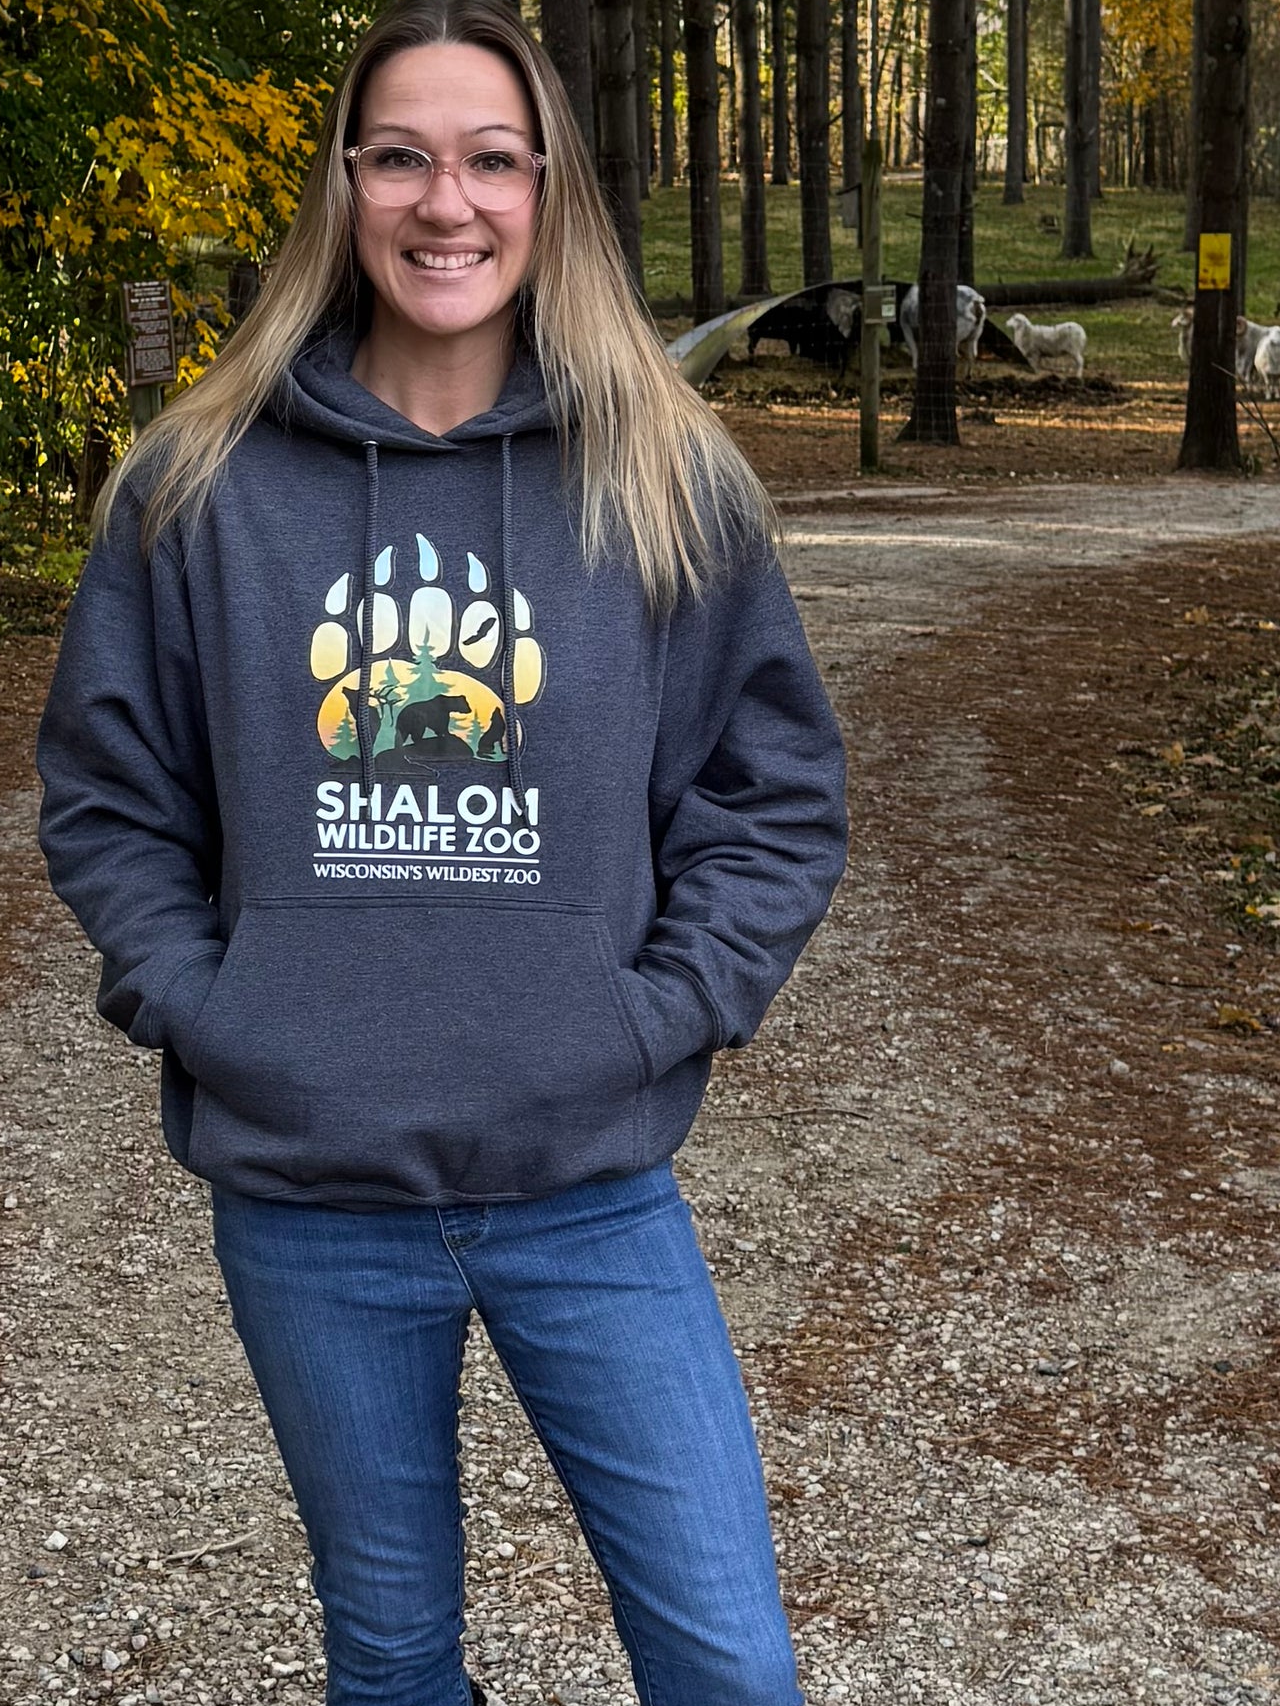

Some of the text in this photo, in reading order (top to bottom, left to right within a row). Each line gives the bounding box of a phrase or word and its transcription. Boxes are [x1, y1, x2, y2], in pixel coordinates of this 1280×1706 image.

[315, 781, 539, 826] SHALOM
[316, 823, 541, 856] WILDLIFE ZOO
[313, 863, 541, 886] WISCONSIN'S WILDEST ZOO
